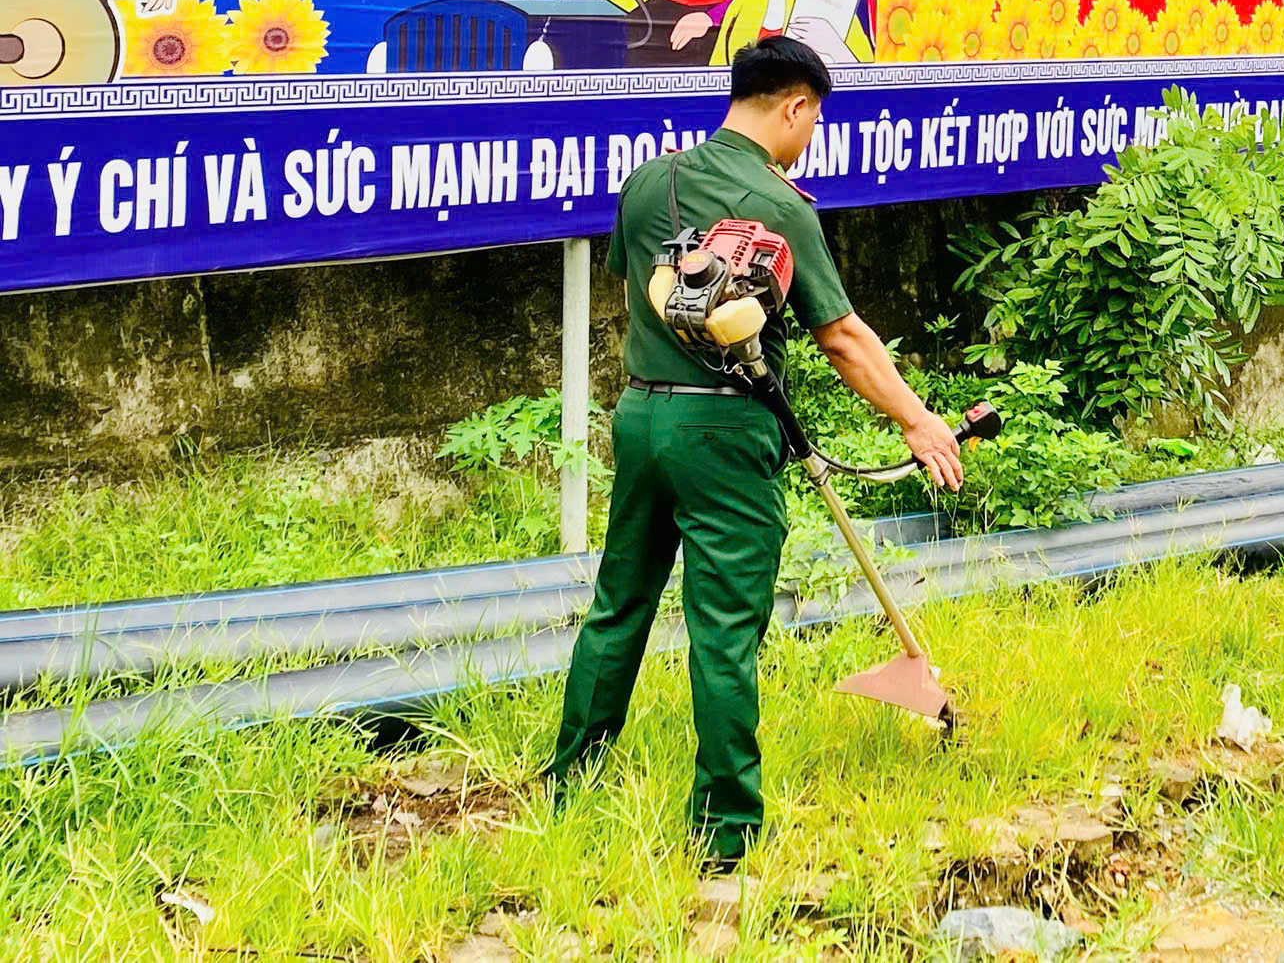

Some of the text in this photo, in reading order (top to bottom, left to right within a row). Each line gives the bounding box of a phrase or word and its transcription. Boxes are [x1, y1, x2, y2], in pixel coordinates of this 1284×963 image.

[47, 146, 82, 236] Ý
[100, 141, 188, 233] CHÍ
[204, 138, 268, 224] VÀ
[283, 129, 376, 219] SỨC
[390, 140, 517, 221] MẠNH
[529, 136, 596, 211] ĐẠI
[859, 109, 913, 184] TỘC
[920, 98, 971, 169] KẾT
[976, 109, 1028, 174] HỢP
[1036, 96, 1075, 159] VỚI
[1080, 94, 1128, 156] SỨC
